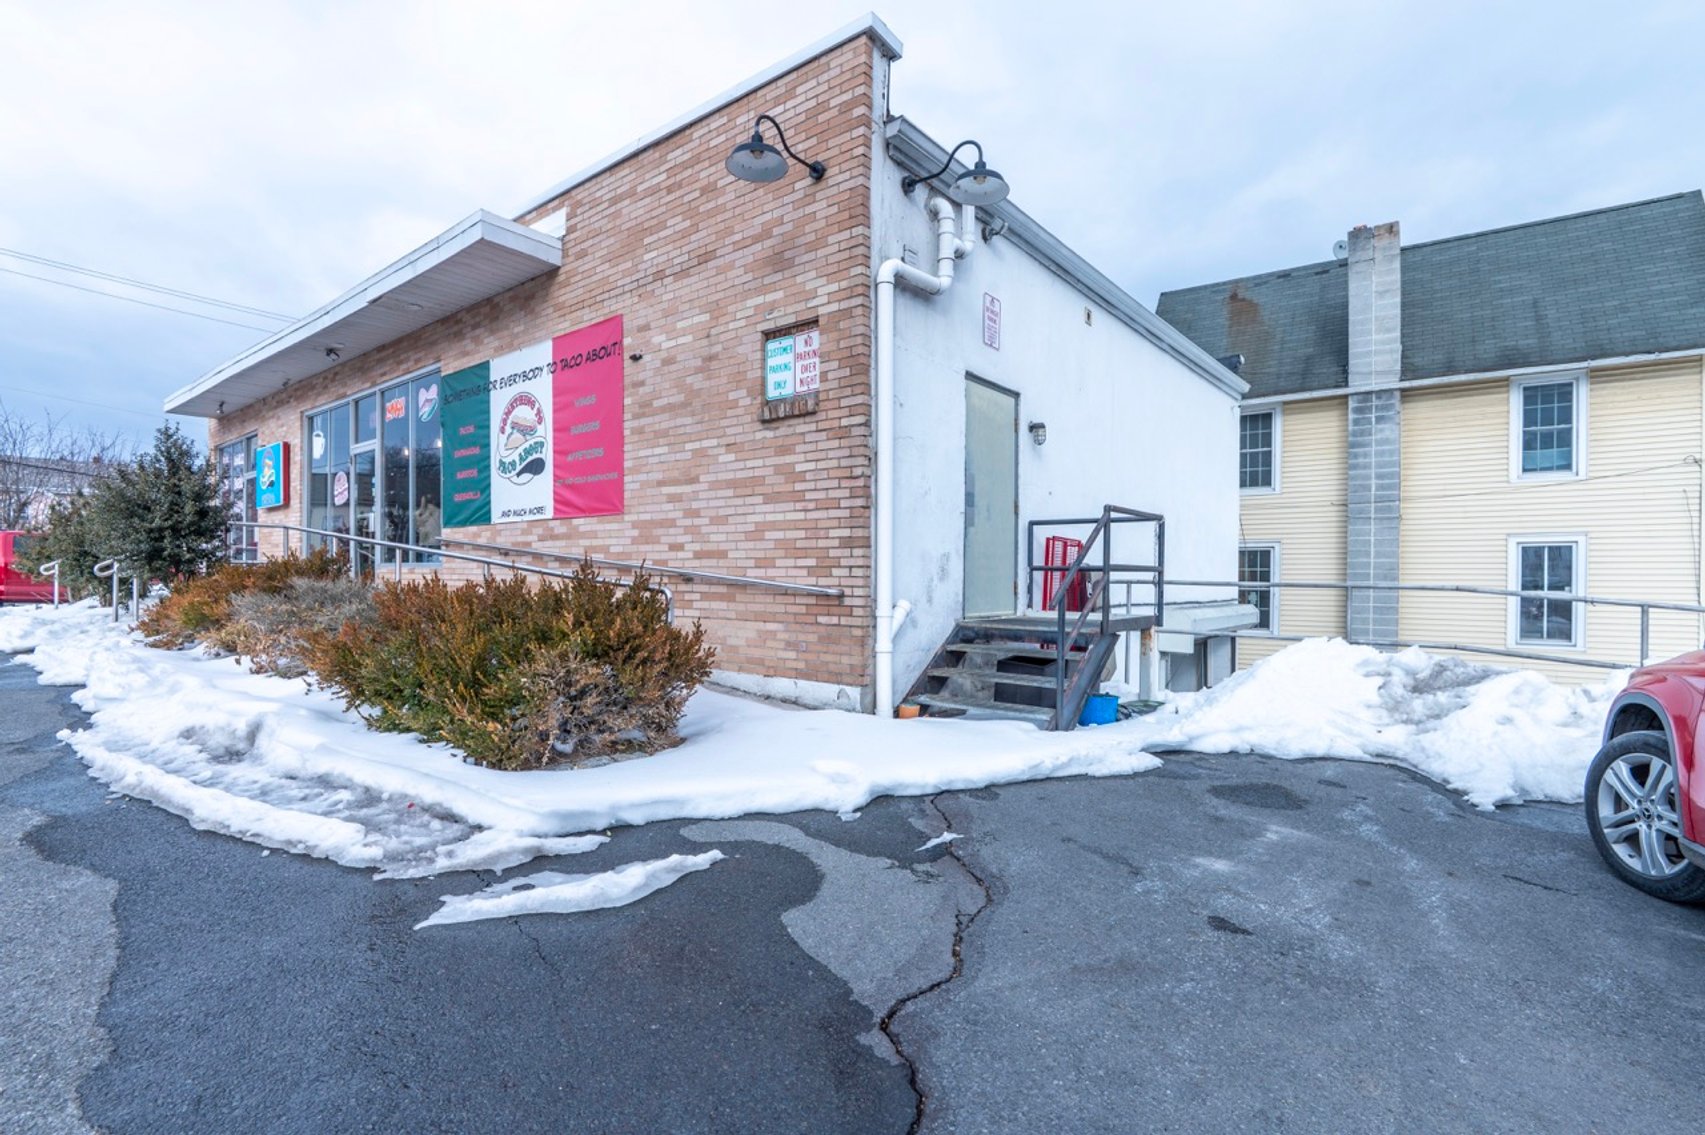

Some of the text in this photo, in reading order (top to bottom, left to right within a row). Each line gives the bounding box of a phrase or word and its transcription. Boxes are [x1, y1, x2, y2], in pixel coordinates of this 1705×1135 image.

[803, 335, 814, 348] NO
[767, 344, 793, 359] CUSTOMER
[796, 348, 820, 362] PARKING
[483, 379, 498, 395] FOR
[499, 365, 545, 390] EVERYBODY
[546, 361, 558, 376] TO
[559, 353, 584, 371] TACO
[585, 341, 622, 364] ABOUT!
[768, 361, 792, 374] PARKING
[800, 362, 817, 375] OVER
[773, 379, 788, 391] ONLY
[799, 374, 818, 388] NIGHT
[498, 458, 517, 475] TACO
[518, 440, 545, 466] ABOUT
[512, 508, 527, 517] MUCH
